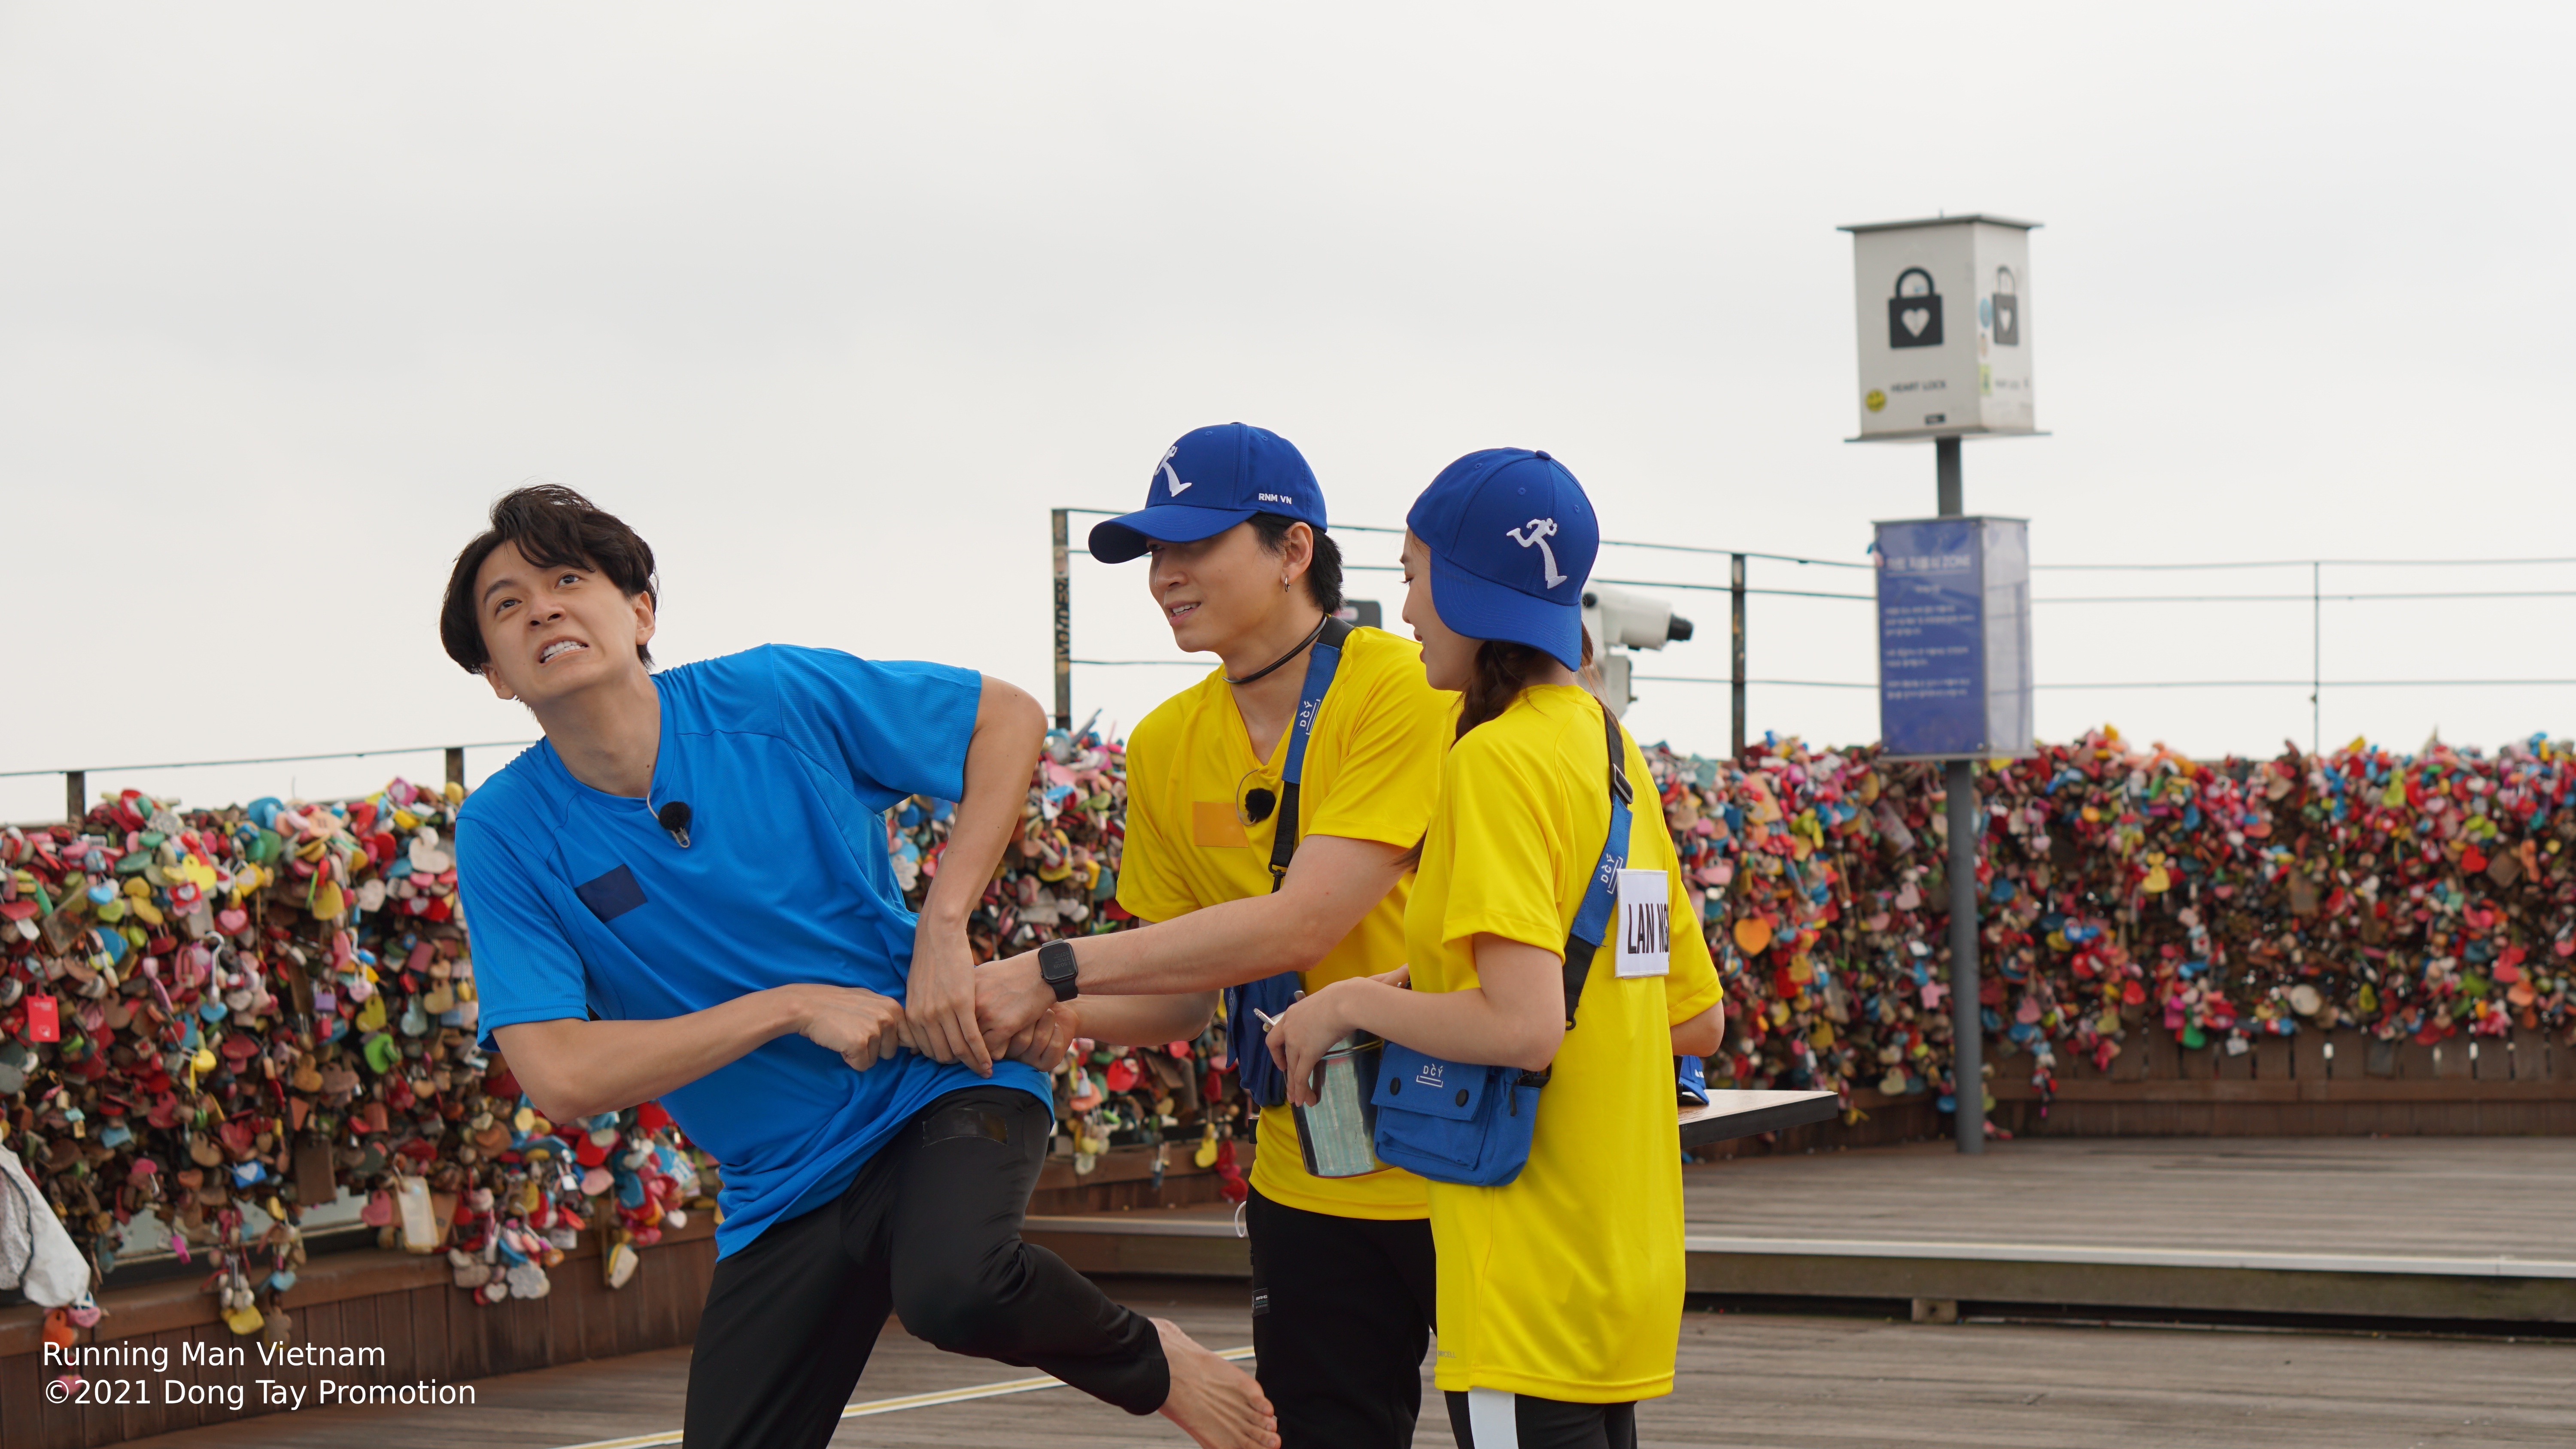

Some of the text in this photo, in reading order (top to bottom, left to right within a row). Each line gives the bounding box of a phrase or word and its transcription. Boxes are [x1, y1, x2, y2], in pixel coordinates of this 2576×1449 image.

[1258, 493, 1292, 504] RNM VN
[1628, 903, 1655, 954] LAN
